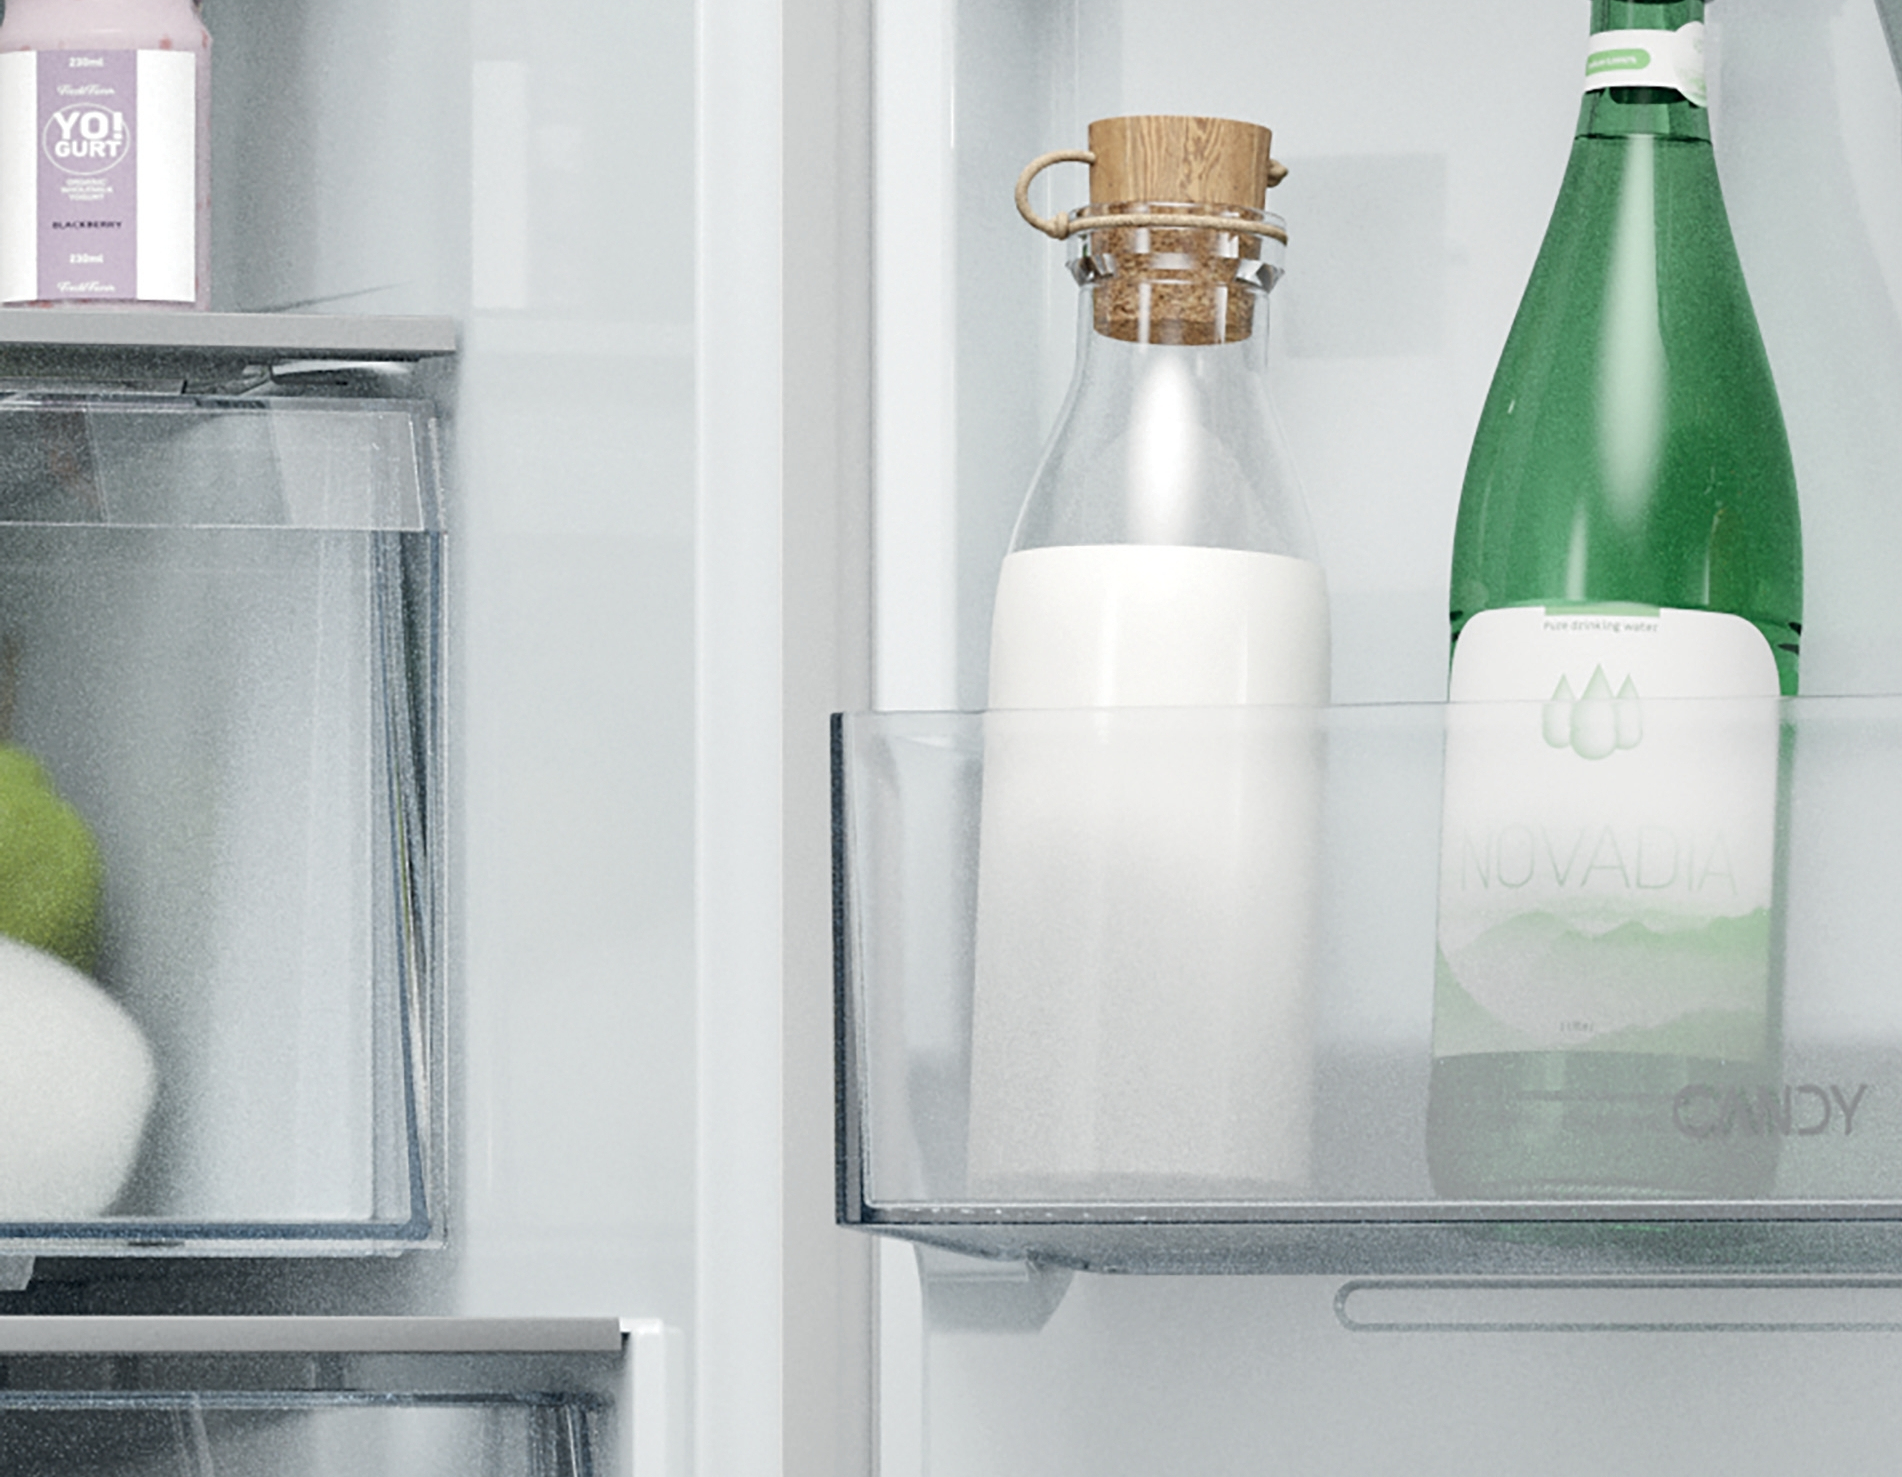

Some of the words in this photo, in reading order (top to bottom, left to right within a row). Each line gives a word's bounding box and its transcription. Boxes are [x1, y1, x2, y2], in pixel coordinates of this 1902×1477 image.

[53, 110, 123, 140] YO!
[54, 140, 123, 158] GURT
[52, 221, 122, 230] BLACKBERRY
[1460, 821, 1739, 896] NOVADIA
[1672, 1083, 1869, 1139] CANDY
